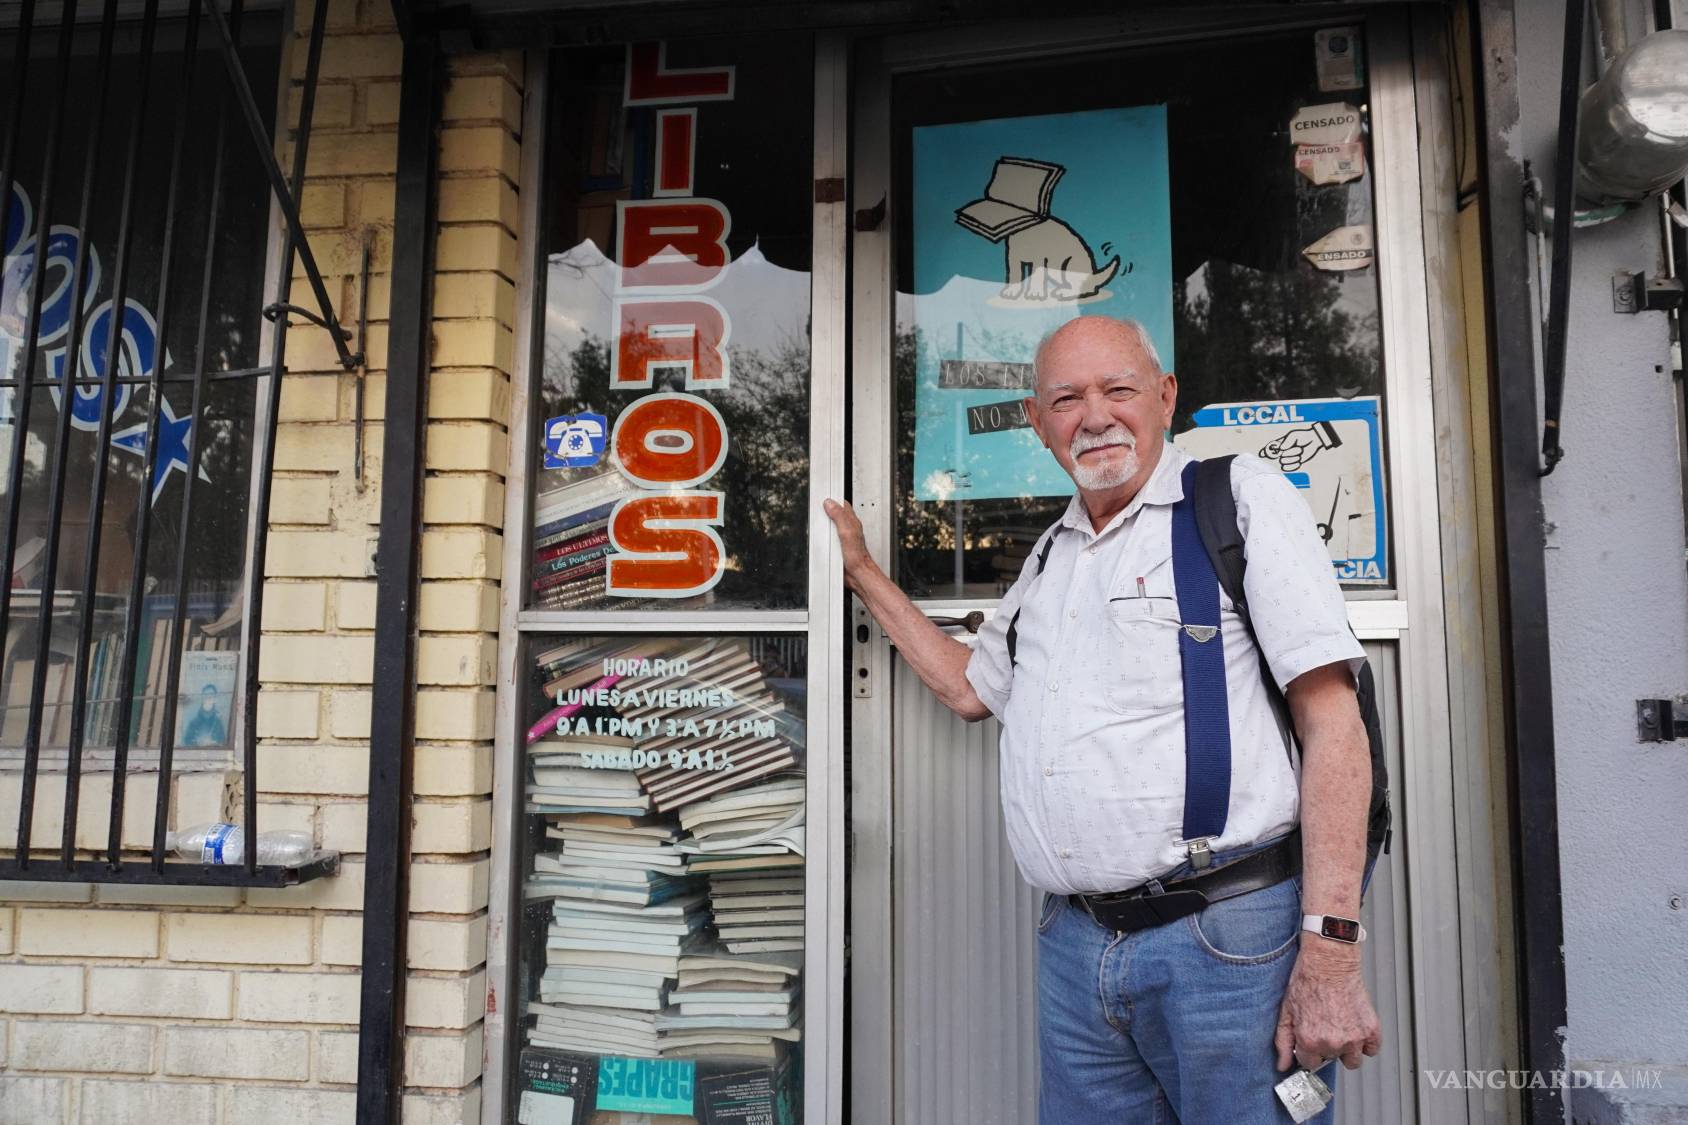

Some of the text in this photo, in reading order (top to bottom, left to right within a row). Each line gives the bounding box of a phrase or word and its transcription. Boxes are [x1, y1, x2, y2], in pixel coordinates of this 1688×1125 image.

[1295, 115, 1354, 131] CENSADO
[1298, 146, 1341, 156] CENSADO
[606, 41, 735, 598] LIBROS
[945, 363, 985, 386] LOS
[973, 406, 1001, 430] NO
[1223, 405, 1304, 425] LOCAL
[551, 560, 567, 571] Los
[569, 551, 600, 565] Poderes
[603, 658, 689, 677] HORARIO
[556, 689, 734, 708] LUNES A VIERNES
[648, 718, 660, 736] Y
[581, 750, 661, 769] SABADO
[598, 1057, 694, 1101] GRAPES
